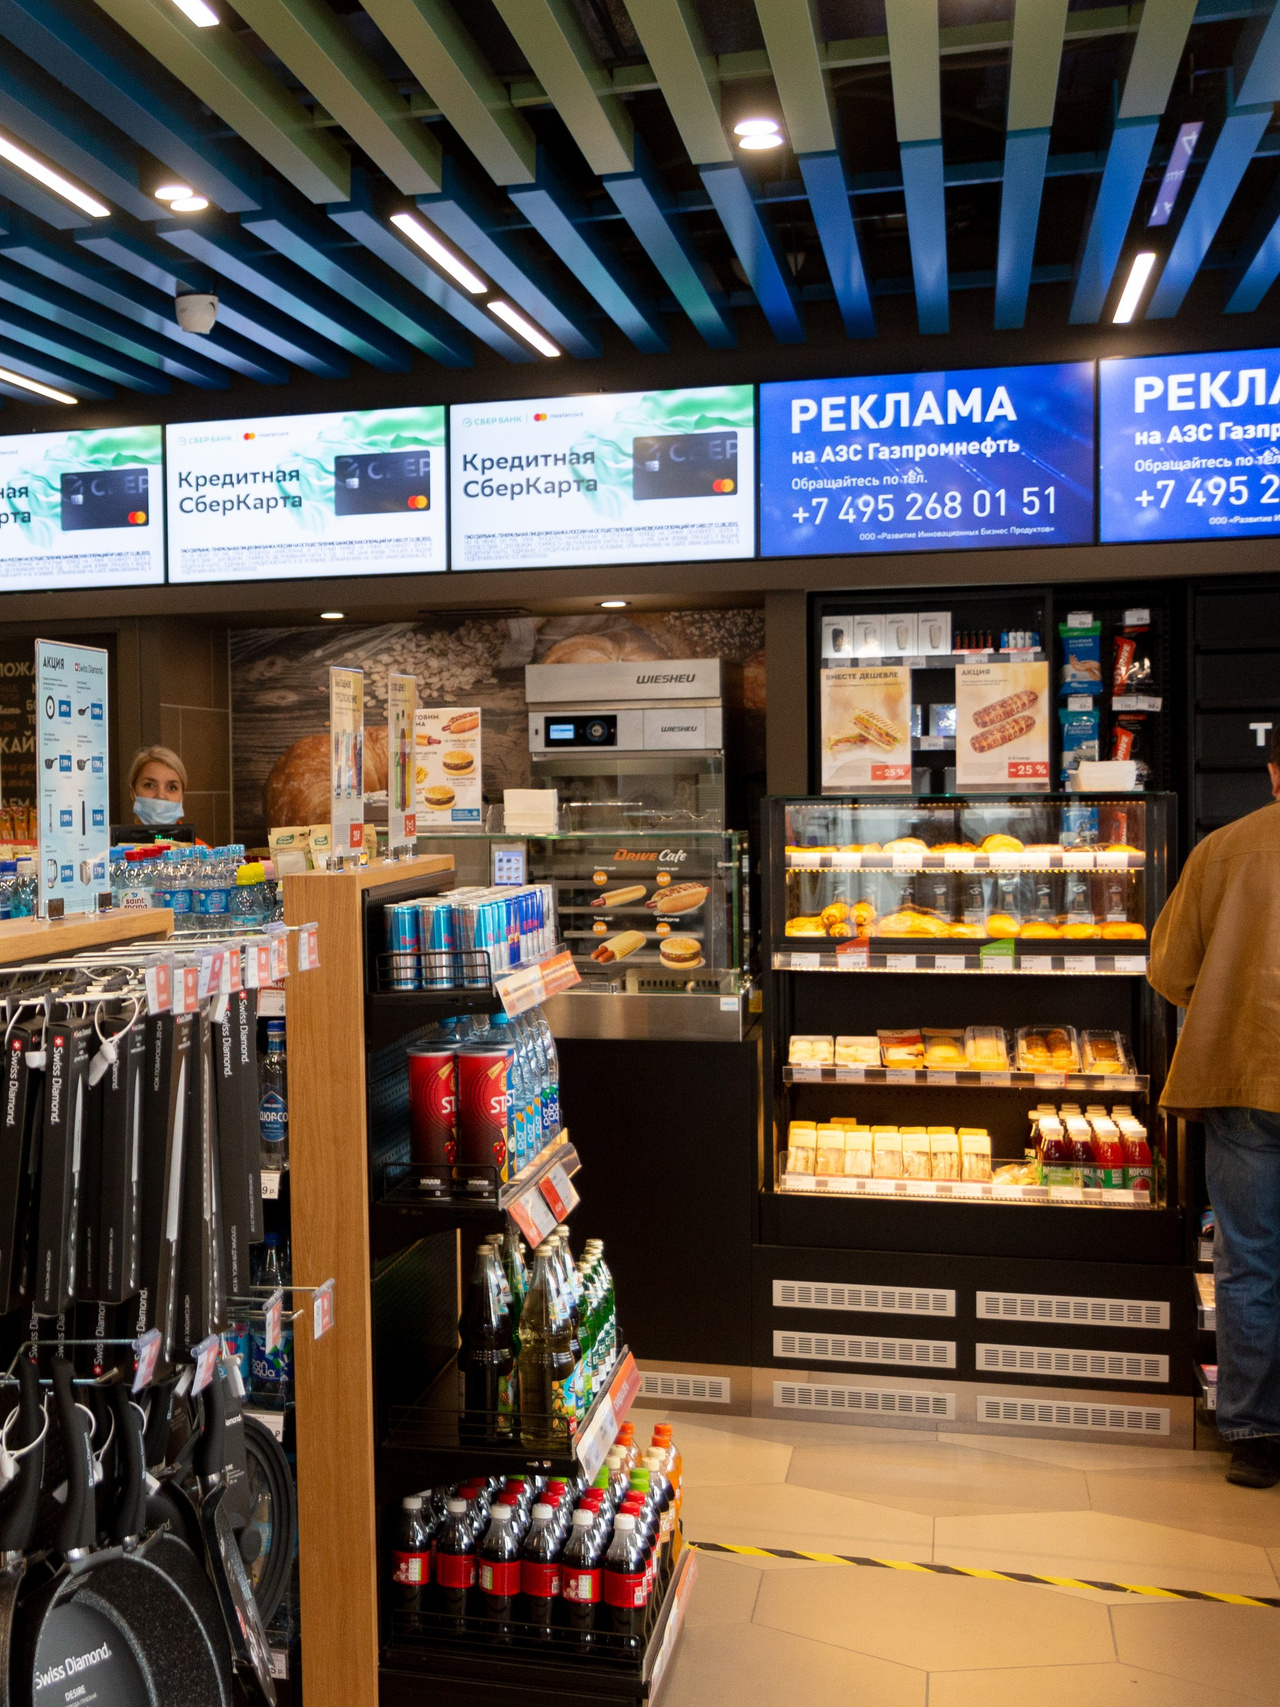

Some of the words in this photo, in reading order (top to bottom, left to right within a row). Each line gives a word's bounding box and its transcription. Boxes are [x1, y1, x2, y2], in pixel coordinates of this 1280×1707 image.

[791, 386, 1017, 434] РЕКЛАМА
[1135, 430, 1161, 445] на
[1167, 423, 1213, 444] АЗС
[792, 449, 815, 464] на
[820, 445, 862, 463] АЗС
[868, 436, 1020, 461] Газпромнефть
[462, 451, 595, 475] Кредитная
[1134, 457, 1232, 474] Обращайтесь
[1235, 455, 1254, 467] по
[178, 469, 300, 491] Кредитная
[463, 476, 598, 500] СберКарта
[791, 475, 880, 492] Обращайтесь
[883, 475, 899, 485] по
[1135, 479, 1176, 509] +7
[1185, 475, 1249, 506] 495
[179, 493, 302, 516] СберКарта
[792, 497, 829, 525] +7
[838, 494, 895, 524] 495
[905, 491, 962, 521] 268
[973, 489, 1007, 517] 01
[1022, 486, 1056, 516] 51
[1209, 517, 1227, 525] ООО
[860, 533, 876, 541] ООО
[877, 530, 917, 540] «Развитие
[917, 528, 979, 539] Инновационных
[980, 526, 1008, 536] Бизнес
[1009, 524, 1055, 535] Продуктов»
[43, 656, 65, 671] АКЦИЯ
[961, 668, 990, 676] АКЦИЯ
[636, 674, 696, 684] WIESHEU
[826, 673, 857, 681] ВМЕСТЕ
[858, 671, 899, 680] ДЕШЕВЛЕ
[614, 849, 658, 862] DRIVE
[659, 849, 687, 862] Cafe
[125, 897, 145, 905] saint
[239, 999, 248, 1024] Swiss
[221, 1010, 231, 1036] Swiss
[9, 1050, 21, 1080] Swiss
[52, 1047, 63, 1076] Swiss
[34, 1664, 66, 1690] Swiss
[65, 1684, 86, 1701] DESIRE
